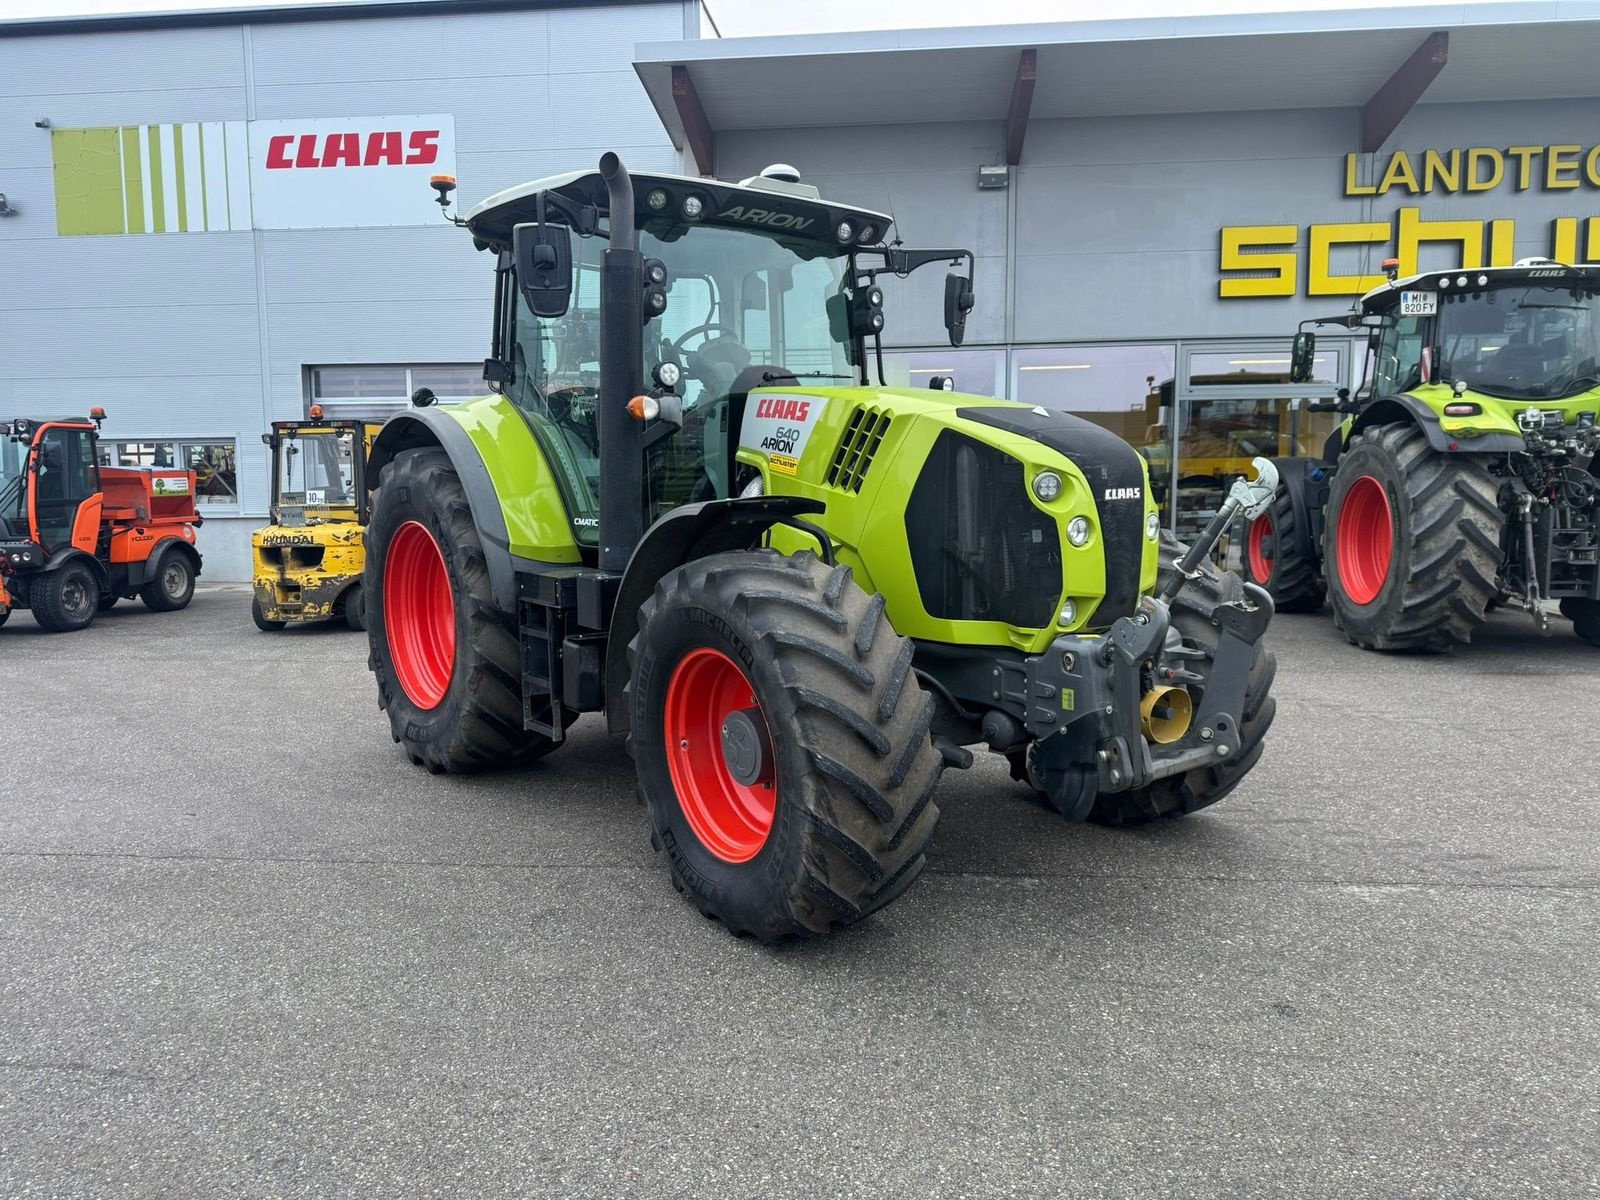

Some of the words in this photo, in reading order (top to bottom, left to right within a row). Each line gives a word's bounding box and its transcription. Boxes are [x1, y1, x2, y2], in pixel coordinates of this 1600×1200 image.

[266, 130, 440, 169] CLAAS
[718, 206, 815, 230] ARION
[1528, 269, 1567, 278] CLAAS
[756, 399, 811, 422] CLAAS
[776, 426, 800, 442] 640
[761, 436, 794, 454] ARION
[1104, 487, 1141, 500] CLAAS
[574, 517, 600, 527] CMATIC
[263, 535, 314, 545] HYUNDAI
[689, 607, 755, 667] MICHELIN
